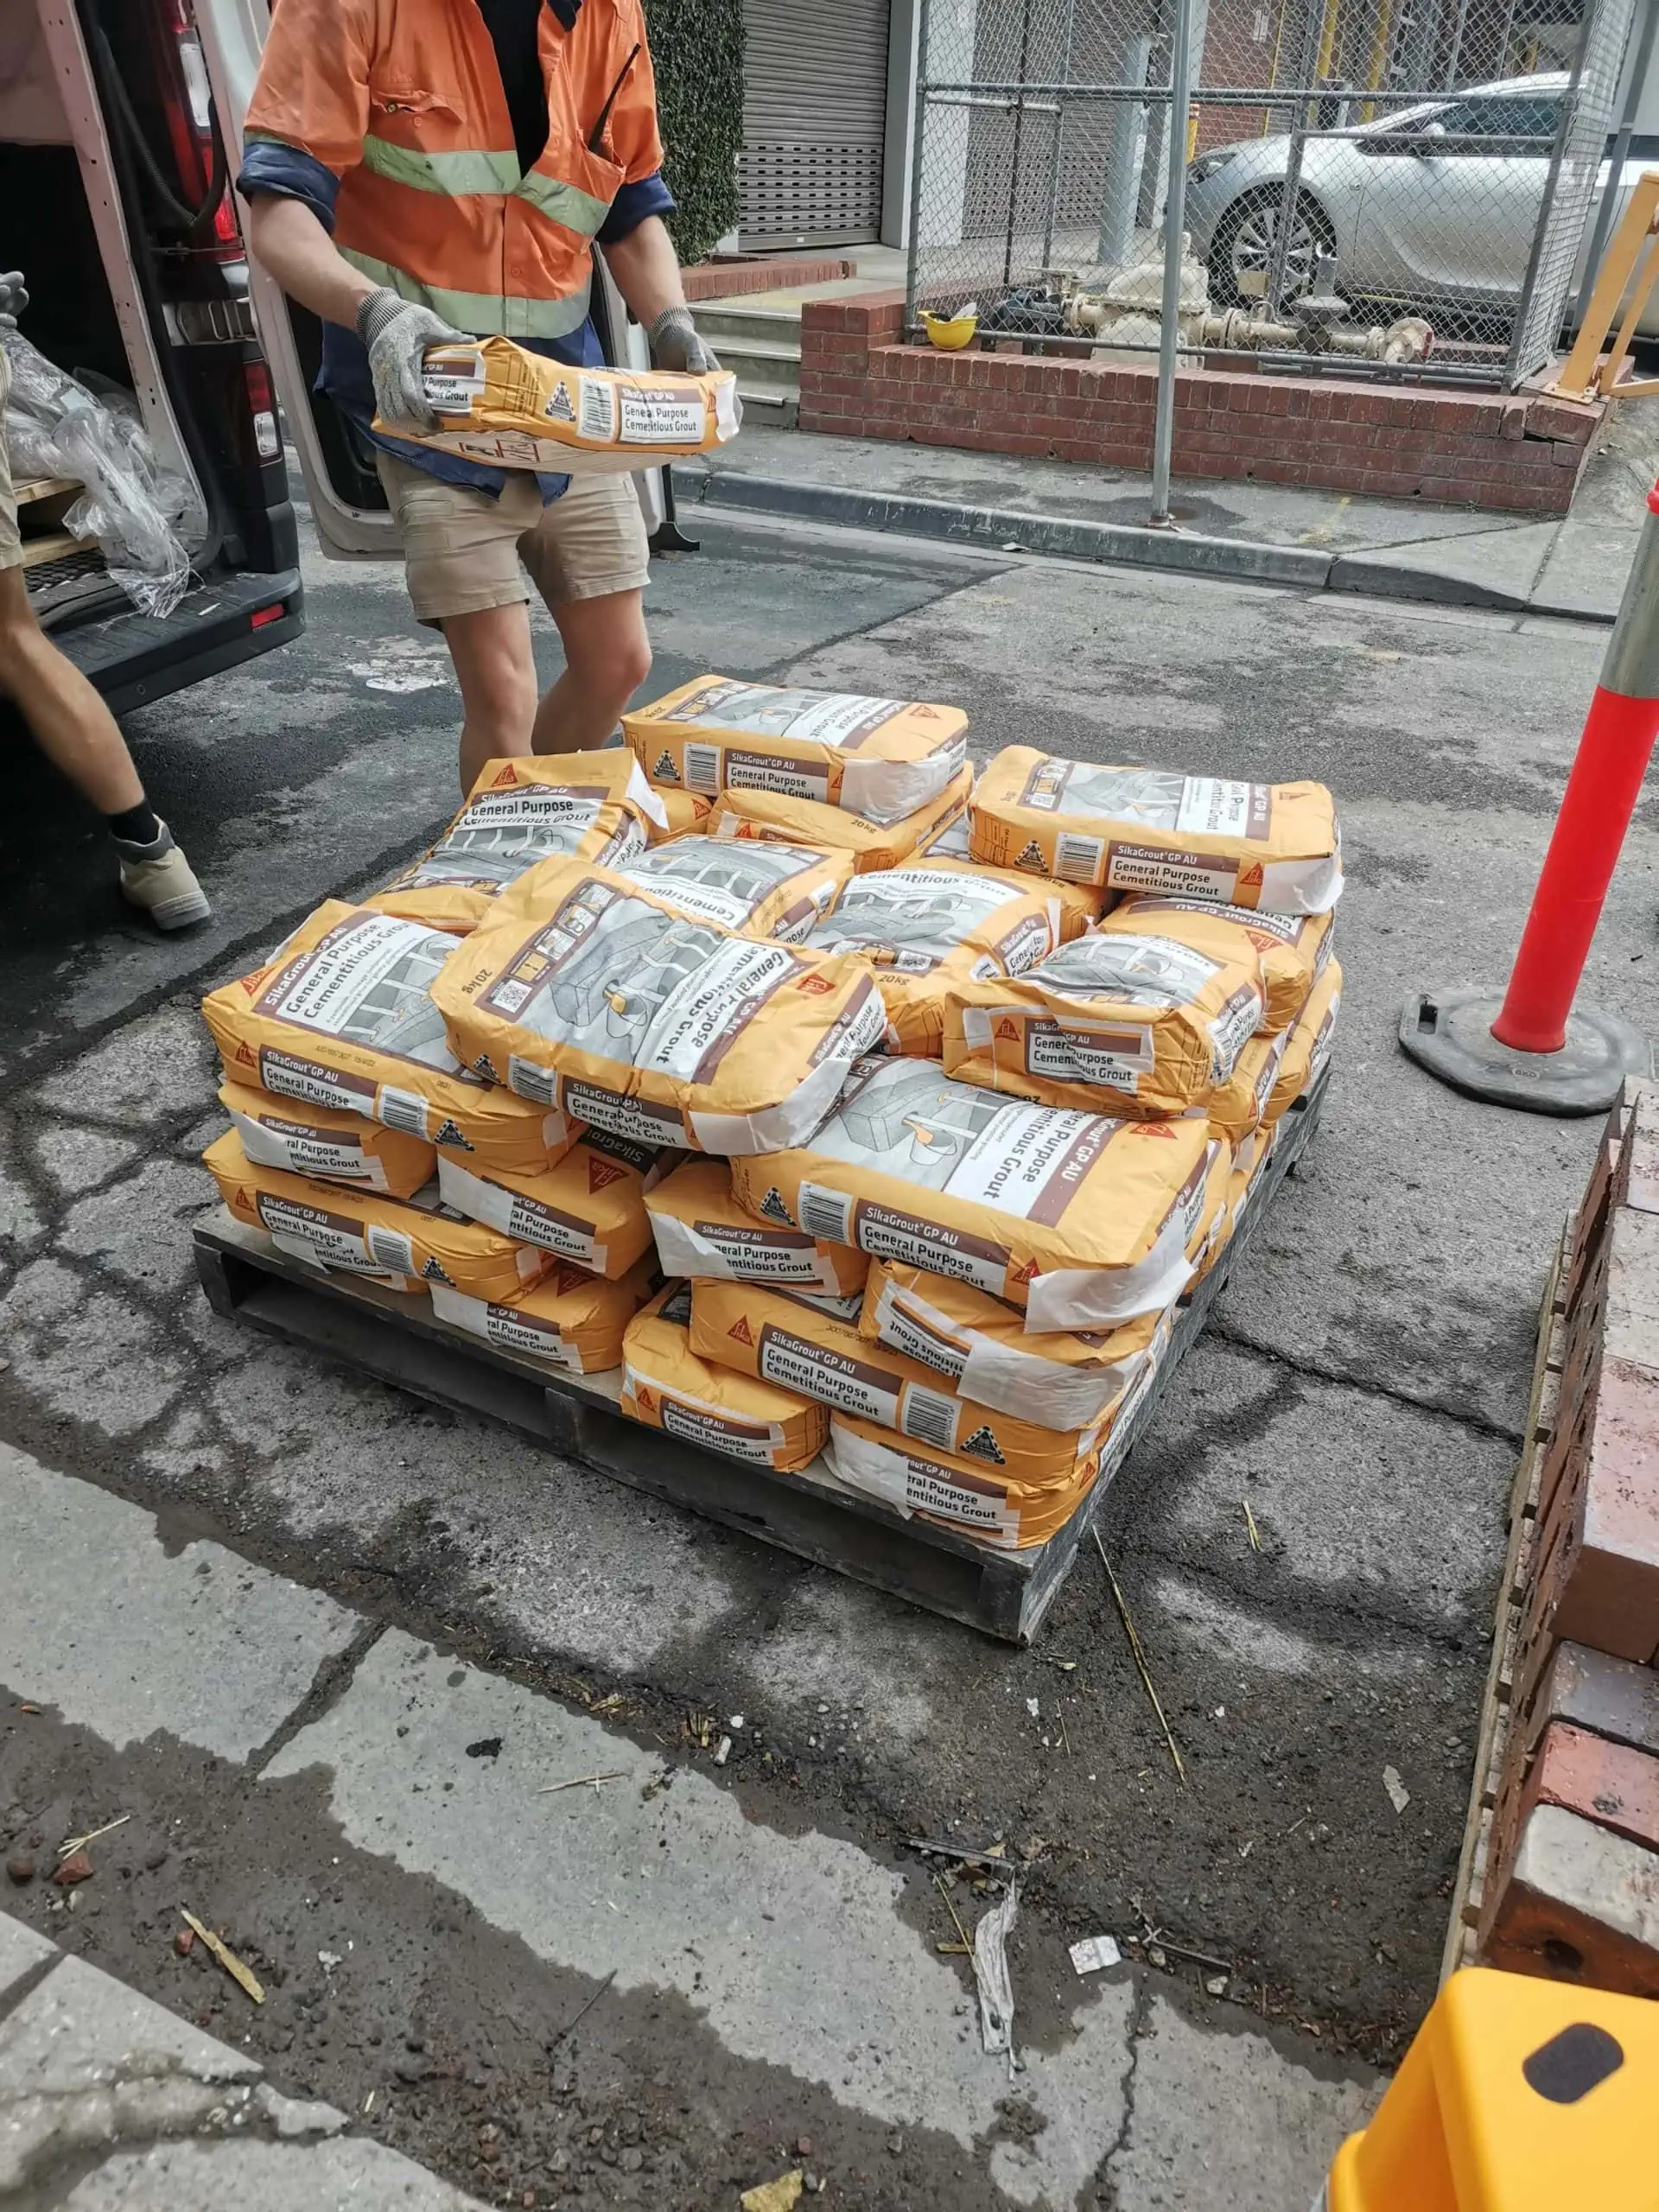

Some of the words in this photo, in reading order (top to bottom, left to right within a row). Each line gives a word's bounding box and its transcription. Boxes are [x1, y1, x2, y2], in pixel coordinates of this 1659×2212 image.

[657, 407, 690, 422] Purpose
[675, 422, 696, 431] Grout
[731, 766, 766, 781] General
[768, 772, 806, 788] Purpose
[471, 802, 518, 817] General
[521, 800, 574, 816] Purpose
[553, 813, 592, 822] Grout
[1167, 853, 1182, 861] GP
[1183, 855, 1198, 864] AU
[1116, 860, 1159, 875] General
[1162, 868, 1211, 884] Purpose
[1113, 872, 1183, 891] Cemetitious
[1185, 883, 1219, 896] Grout
[286, 959, 334, 1014] General
[327, 923, 380, 960] Purpose
[303, 938, 383, 1019] Cementitious
[378, 921, 411, 939] Grou
[739, 950, 784, 999] General
[656, 1020, 693, 1064] Grout
[311, 1066, 323, 1078] GP
[324, 1071, 339, 1083] AU
[1097, 1067, 1134, 1081] Grout
[266, 1068, 304, 1089] General
[307, 1082, 350, 1105] Purpose
[298, 1127, 308, 1135] GP
[643, 1129, 677, 1146] Grout
[301, 1141, 340, 1156] Purpose
[1022, 1128, 1071, 1183] Purpose
[1074, 1145, 1096, 1164] GP
[329, 1159, 360, 1167] Grout
[1061, 1160, 1081, 1182] AU
[983, 1155, 1021, 1199] Grout
[524, 1198, 536, 1208] GP
[535, 1205, 547, 1214] AU
[302, 1209, 315, 1219] GP
[315, 1214, 328, 1224] AU
[264, 1211, 300, 1230] General
[302, 1224, 343, 1245] Purpose
[524, 1214, 569, 1239] Purpose
[923, 1225, 939, 1238] GP
[940, 1231, 959, 1245] AU
[554, 1236, 587, 1252] Grout
[741, 1231, 751, 1240] GP
[752, 1233, 762, 1242] AU
[744, 1248, 791, 1262] Purpose
[865, 1227, 914, 1252] General
[918, 1243, 973, 1273] Purpose
[779, 1262, 813, 1273] Grout
[508, 1311, 518, 1321] AU
[501, 1323, 540, 1340] Purpose
[889, 1319, 919, 1349] Grout
[529, 1341, 559, 1353] Grout
[823, 1354, 839, 1367] GP
[839, 1361, 856, 1375] AU
[767, 1348, 814, 1377] General
[816, 1370, 868, 1401] Purpose
[766, 1362, 841, 1402] Cemetitious
[842, 1394, 879, 1417] Grout
[667, 1414, 702, 1436] General
[704, 1430, 747, 1448] Purpose
[702, 1416, 714, 1426] GP
[714, 1421, 725, 1429] AU
[736, 1446, 767, 1458] Grout
[925, 1464, 938, 1474] GP
[938, 1469, 951, 1479] AU
[928, 1481, 978, 1504] Purpose
[906, 1488, 959, 1512] entitious
[961, 1504, 996, 1519] Grout
